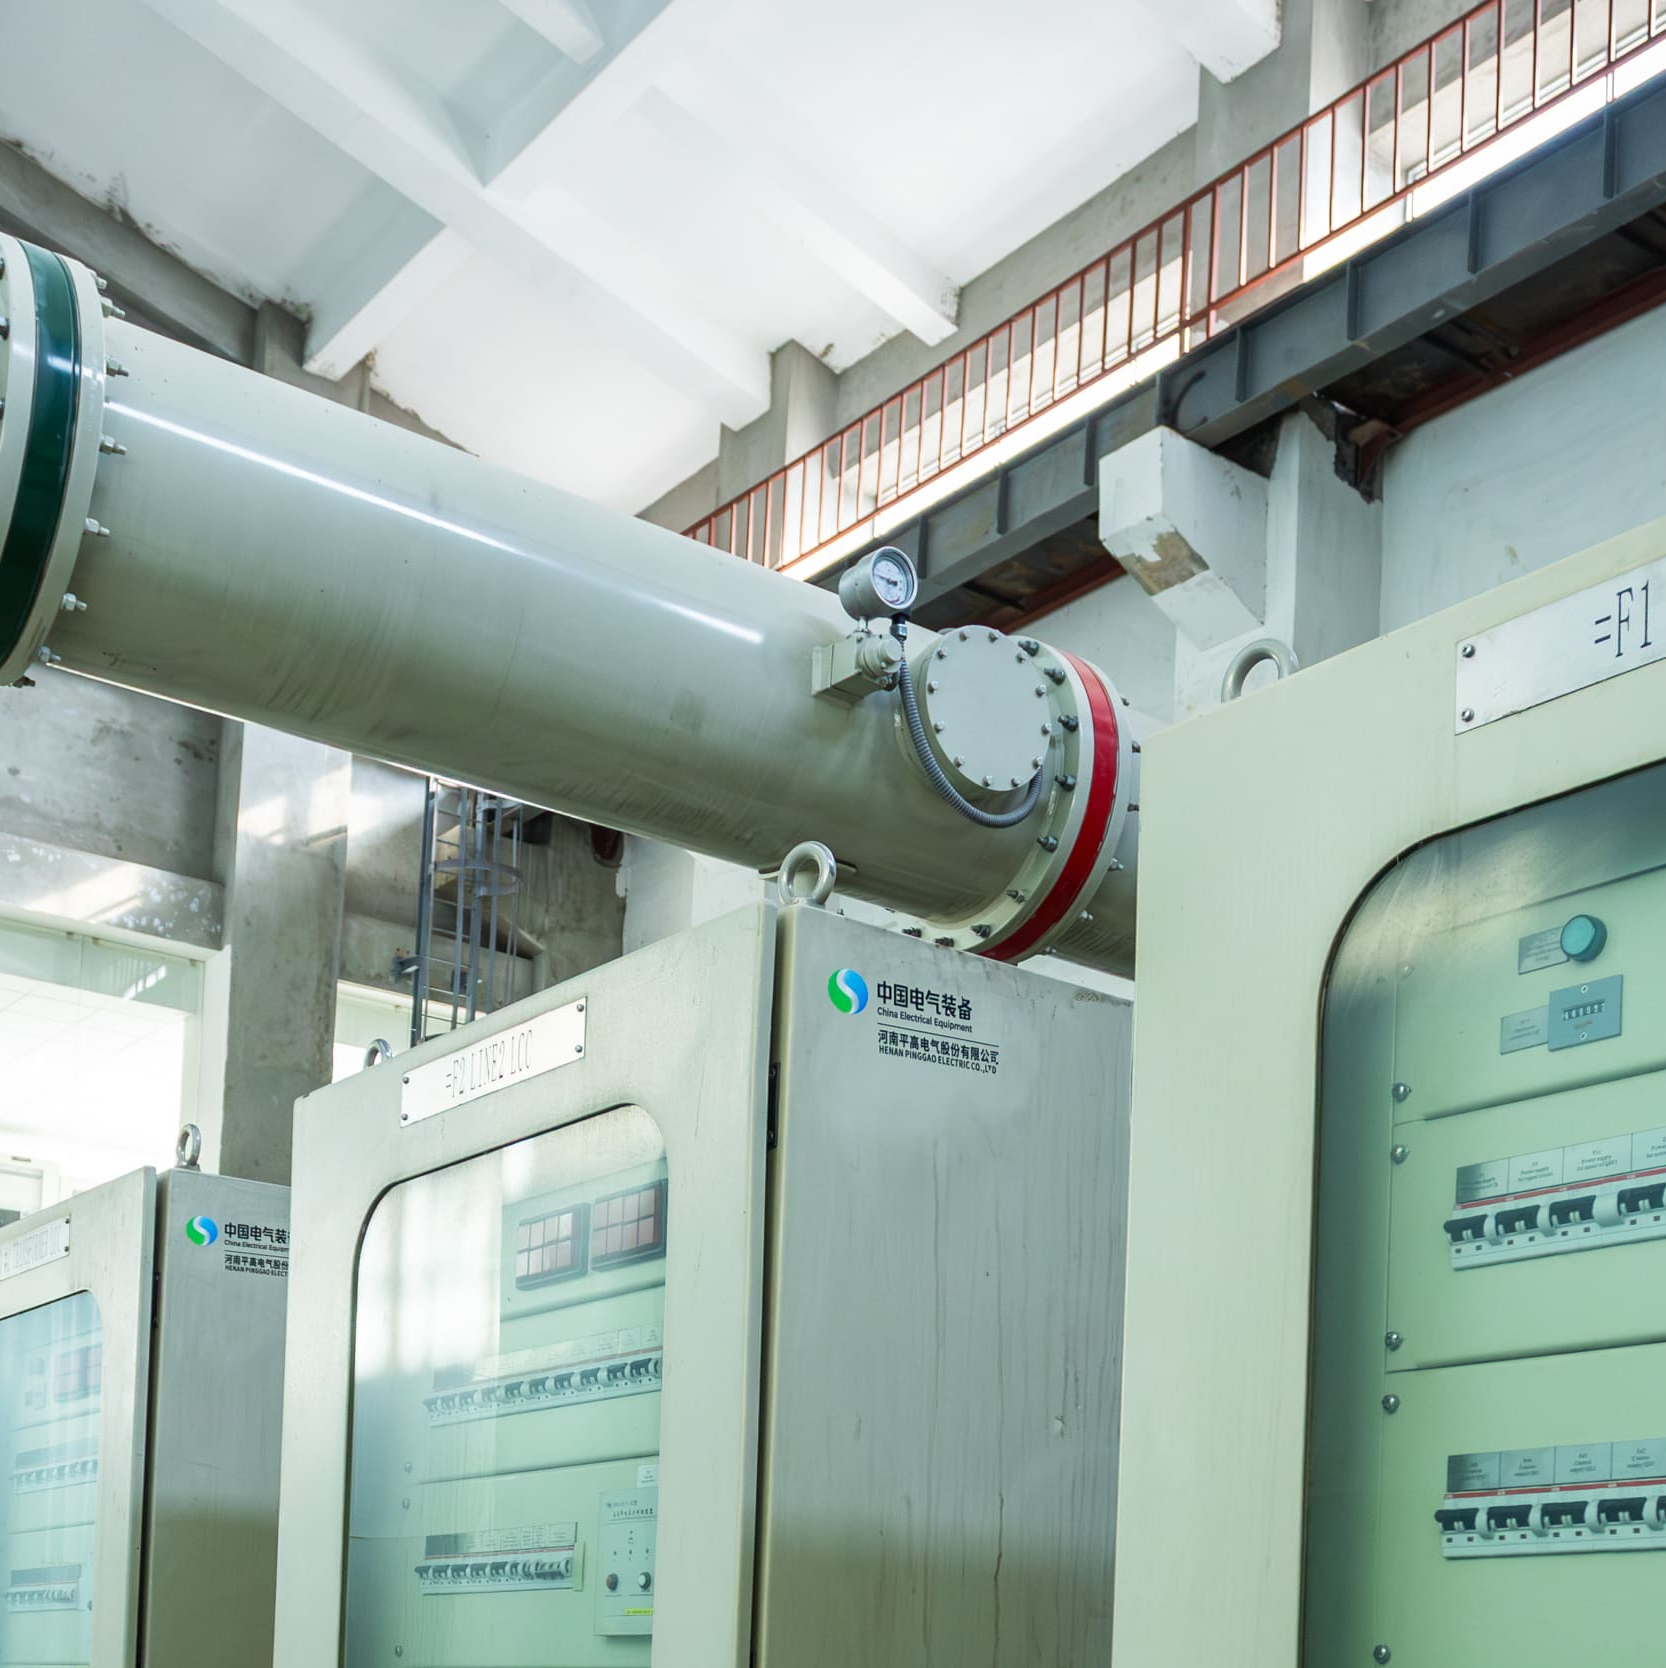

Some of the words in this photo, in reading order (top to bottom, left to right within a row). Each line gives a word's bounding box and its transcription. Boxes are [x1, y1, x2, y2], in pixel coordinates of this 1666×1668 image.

[1594, 581, 1652, 658] =F1
[876, 980, 973, 1021] 中国电气装备
[876, 1006, 899, 1019] China
[900, 1010, 933, 1026] Electrical
[934, 1018, 973, 1033] Equipment
[878, 1029, 1000, 1065] 河南平高电气股份有限公司
[878, 1044, 904, 1058] HENAN
[904, 1049, 937, 1064] PINGGAO
[937, 1055, 970, 1070] ELECTRIC
